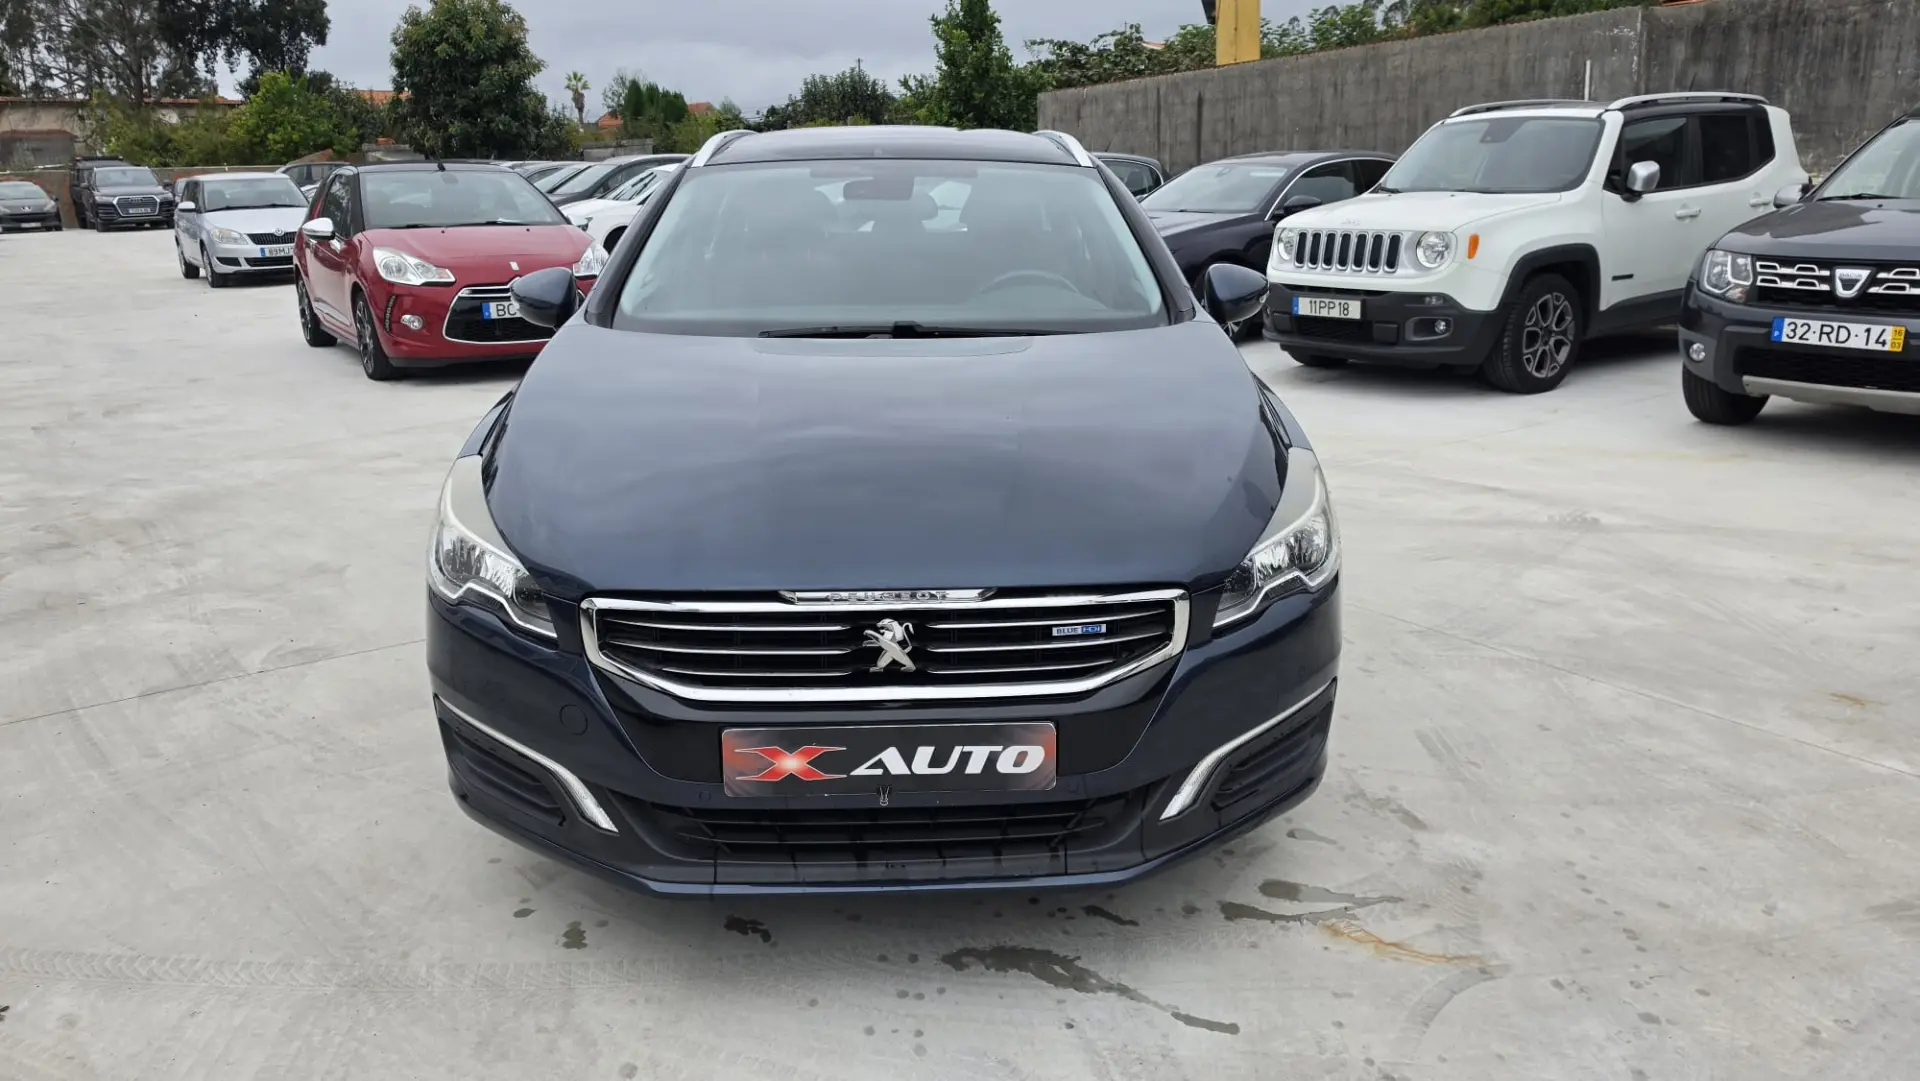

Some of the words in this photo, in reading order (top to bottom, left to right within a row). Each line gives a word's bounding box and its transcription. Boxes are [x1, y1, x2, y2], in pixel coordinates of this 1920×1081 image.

[828, 591, 949, 601] PEUGEOT
[734, 746, 847, 781] X
[850, 745, 1046, 775] AUTO
